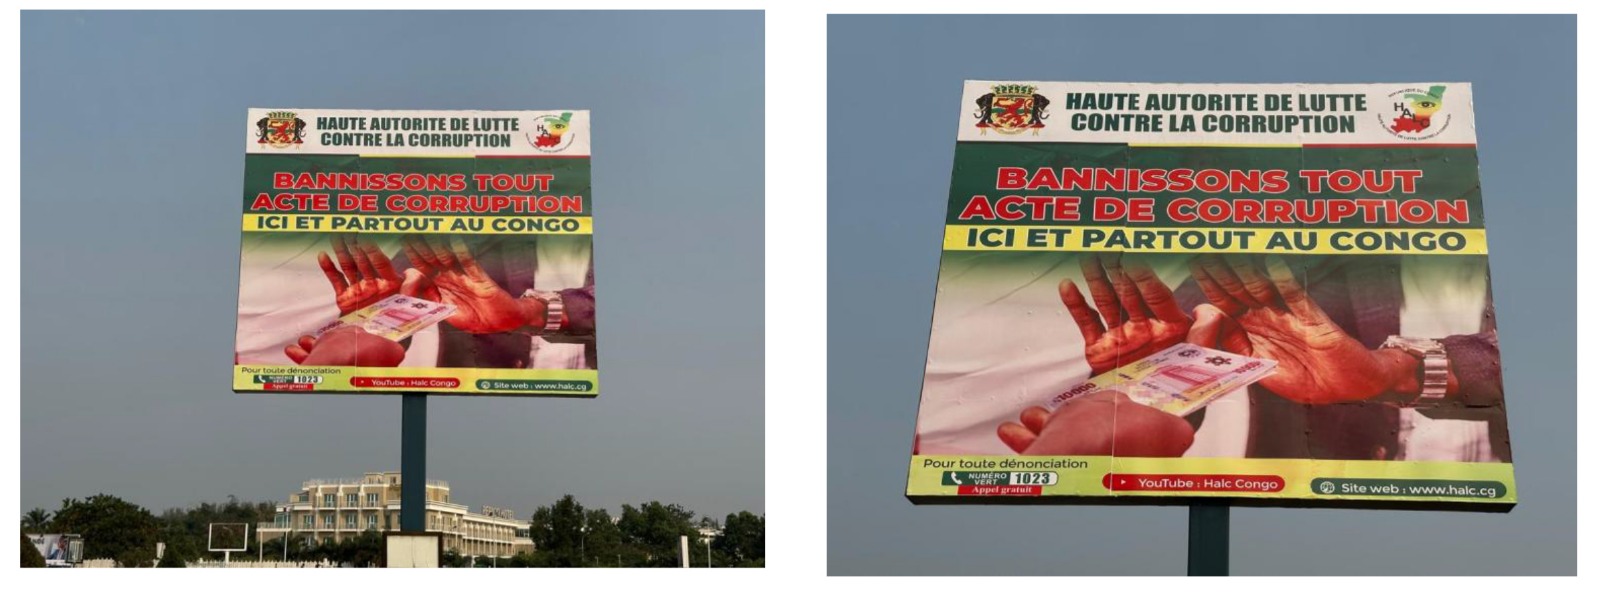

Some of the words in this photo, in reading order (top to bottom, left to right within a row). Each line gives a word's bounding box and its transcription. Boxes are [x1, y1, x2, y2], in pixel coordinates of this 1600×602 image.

[1066, 92, 1139, 110] HAUTE
[1145, 93, 1258, 111] AUTORITE
[1264, 94, 1293, 112] DE
[1299, 94, 1367, 112] LUTTE
[317, 117, 366, 130] HAUTE
[370, 117, 446, 131] AUTORITE
[451, 118, 469, 131] DE
[473, 118, 519, 131] LUTTE
[1071, 113, 1163, 132] CONTRE
[1169, 114, 1196, 132] LA
[1202, 114, 1355, 133] CORRUPTION
[321, 133, 382, 146] CONTRE
[386, 133, 404, 146] LA
[408, 134, 510, 147] CORRUPTION
[274, 172, 467, 191] BANNISSONS
[473, 174, 554, 191] TOUT
[996, 167, 1290, 193] BANNISSONS
[1300, 170, 1422, 194] TOUT
[251, 193, 330, 211] ACTE
[337, 194, 378, 212] DE
[386, 195, 583, 213] CORRUPTION
[958, 195, 1081, 221] ACTE
[1093, 196, 1155, 222] DE
[1167, 198, 1470, 224] CORRUPTION
[257, 216, 287, 229] ICI
[296, 217, 324, 229] ET
[331, 217, 443, 232] PARTOUT
[450, 218, 484, 231] AU
[492, 218, 580, 232] CONGO
[967, 228, 1015, 247] ICI
[1027, 228, 1072, 247] ET
[1082, 229, 1255, 250] PARTOUT
[1265, 231, 1317, 251] AU
[1330, 231, 1466, 251] CONGO
[534, 383, 586, 391] www.halc.cg
[923, 459, 955, 468] Pour
[960, 460, 996, 468] toute
[1000, 459, 1088, 468] dénonciation
[1015, 473, 1050, 484] 1023
[1139, 478, 1193, 488] YouTube
[1204, 479, 1236, 488] Halc
[1238, 479, 1278, 491] Congo
[972, 486, 999, 494] Appel
[1002, 486, 1032, 494] gratuit
[1342, 483, 1367, 494] Site
[1370, 483, 1399, 494] web
[1409, 485, 1496, 498] www.halc.cg
